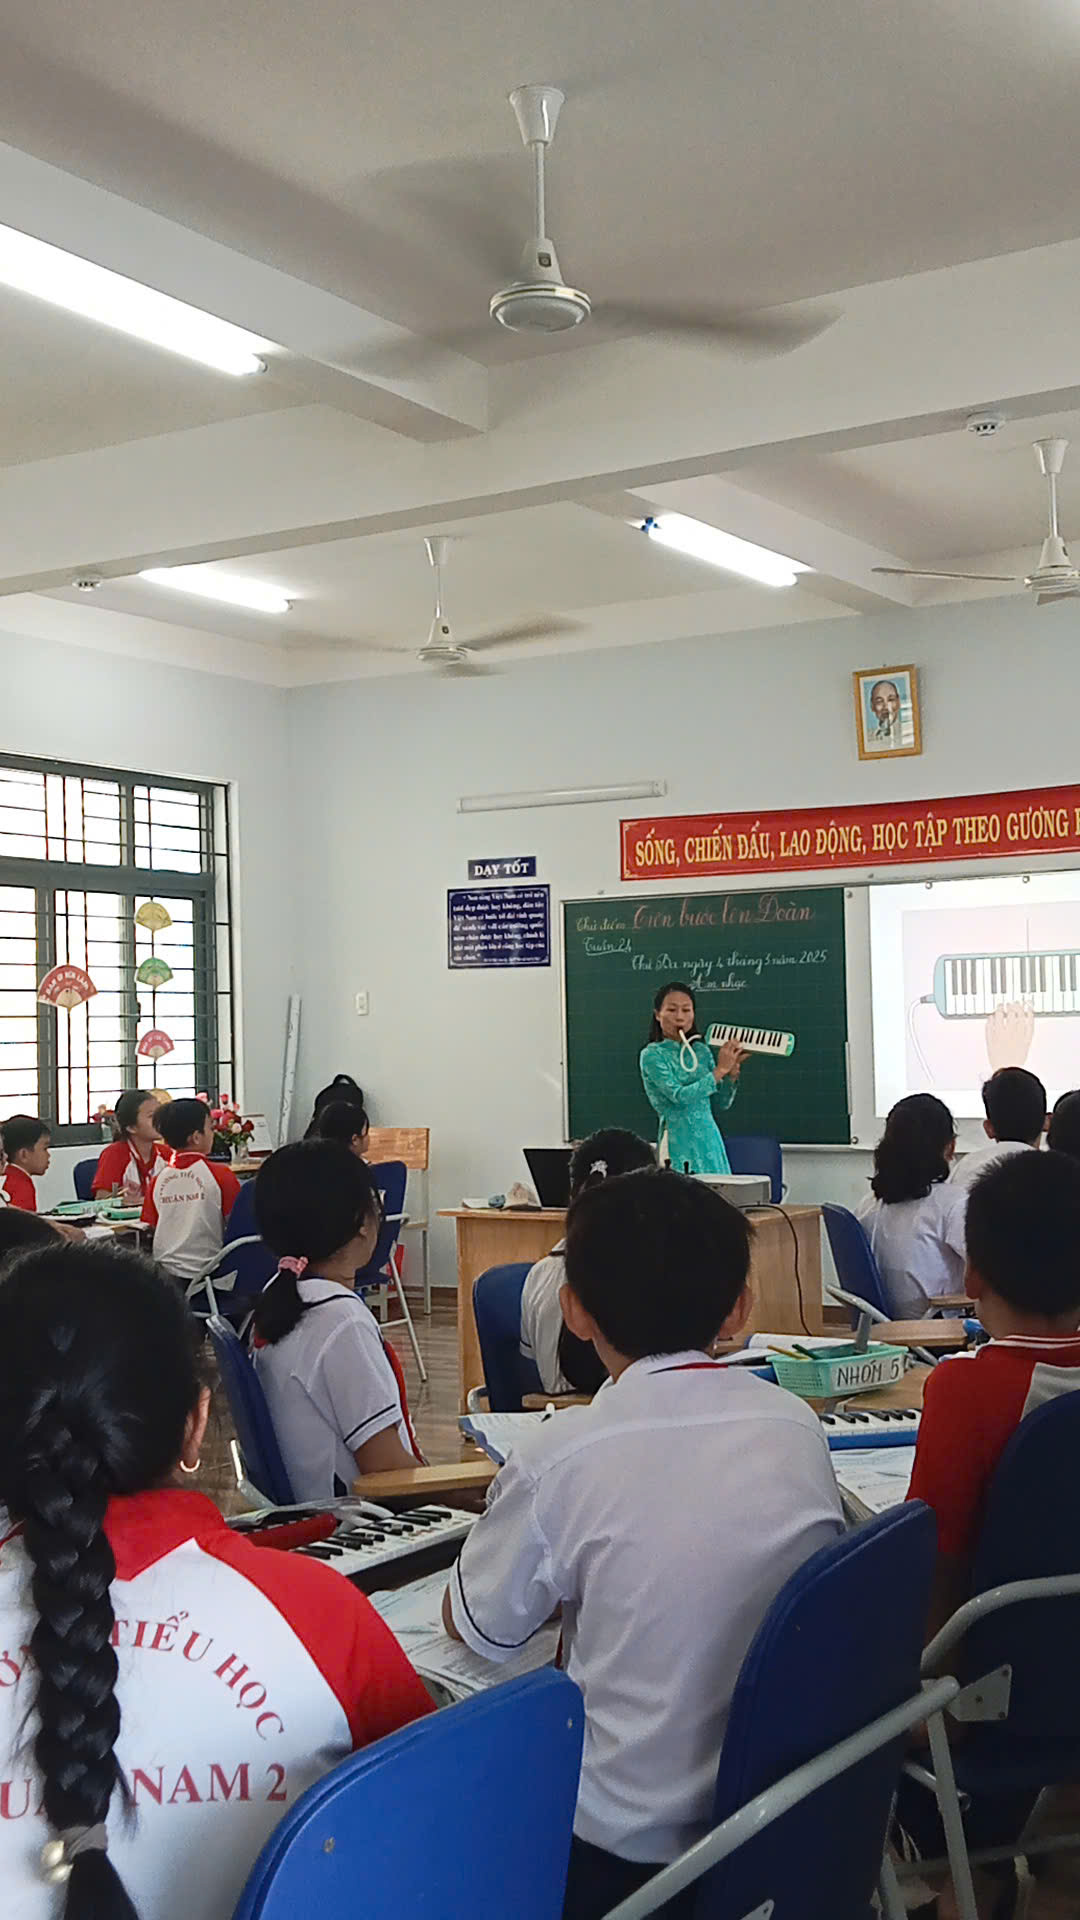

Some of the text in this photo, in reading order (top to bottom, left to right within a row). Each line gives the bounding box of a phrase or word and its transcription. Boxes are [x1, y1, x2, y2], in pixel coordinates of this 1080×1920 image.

[635, 828, 680, 867] SỐNG,
[684, 823, 732, 863] CHIẾN
[737, 820, 775, 861] ĐẤU,
[780, 829, 811, 857] LAO
[815, 820, 867, 860] ĐỘNG,
[872, 821, 909, 856] HỌC
[913, 812, 948, 853] TẬP
[952, 814, 1000, 845] THEO
[1006, 806, 1069, 841] GƯƠNG
[474, 859, 529, 877] DẠY TỐT
[799, 949, 829, 964] 2025
[837, 1358, 900, 1387] NHÓM 5
[109, 1610, 285, 1741] TIỂU HỌC
[130, 1763, 288, 1808] NAM 2
